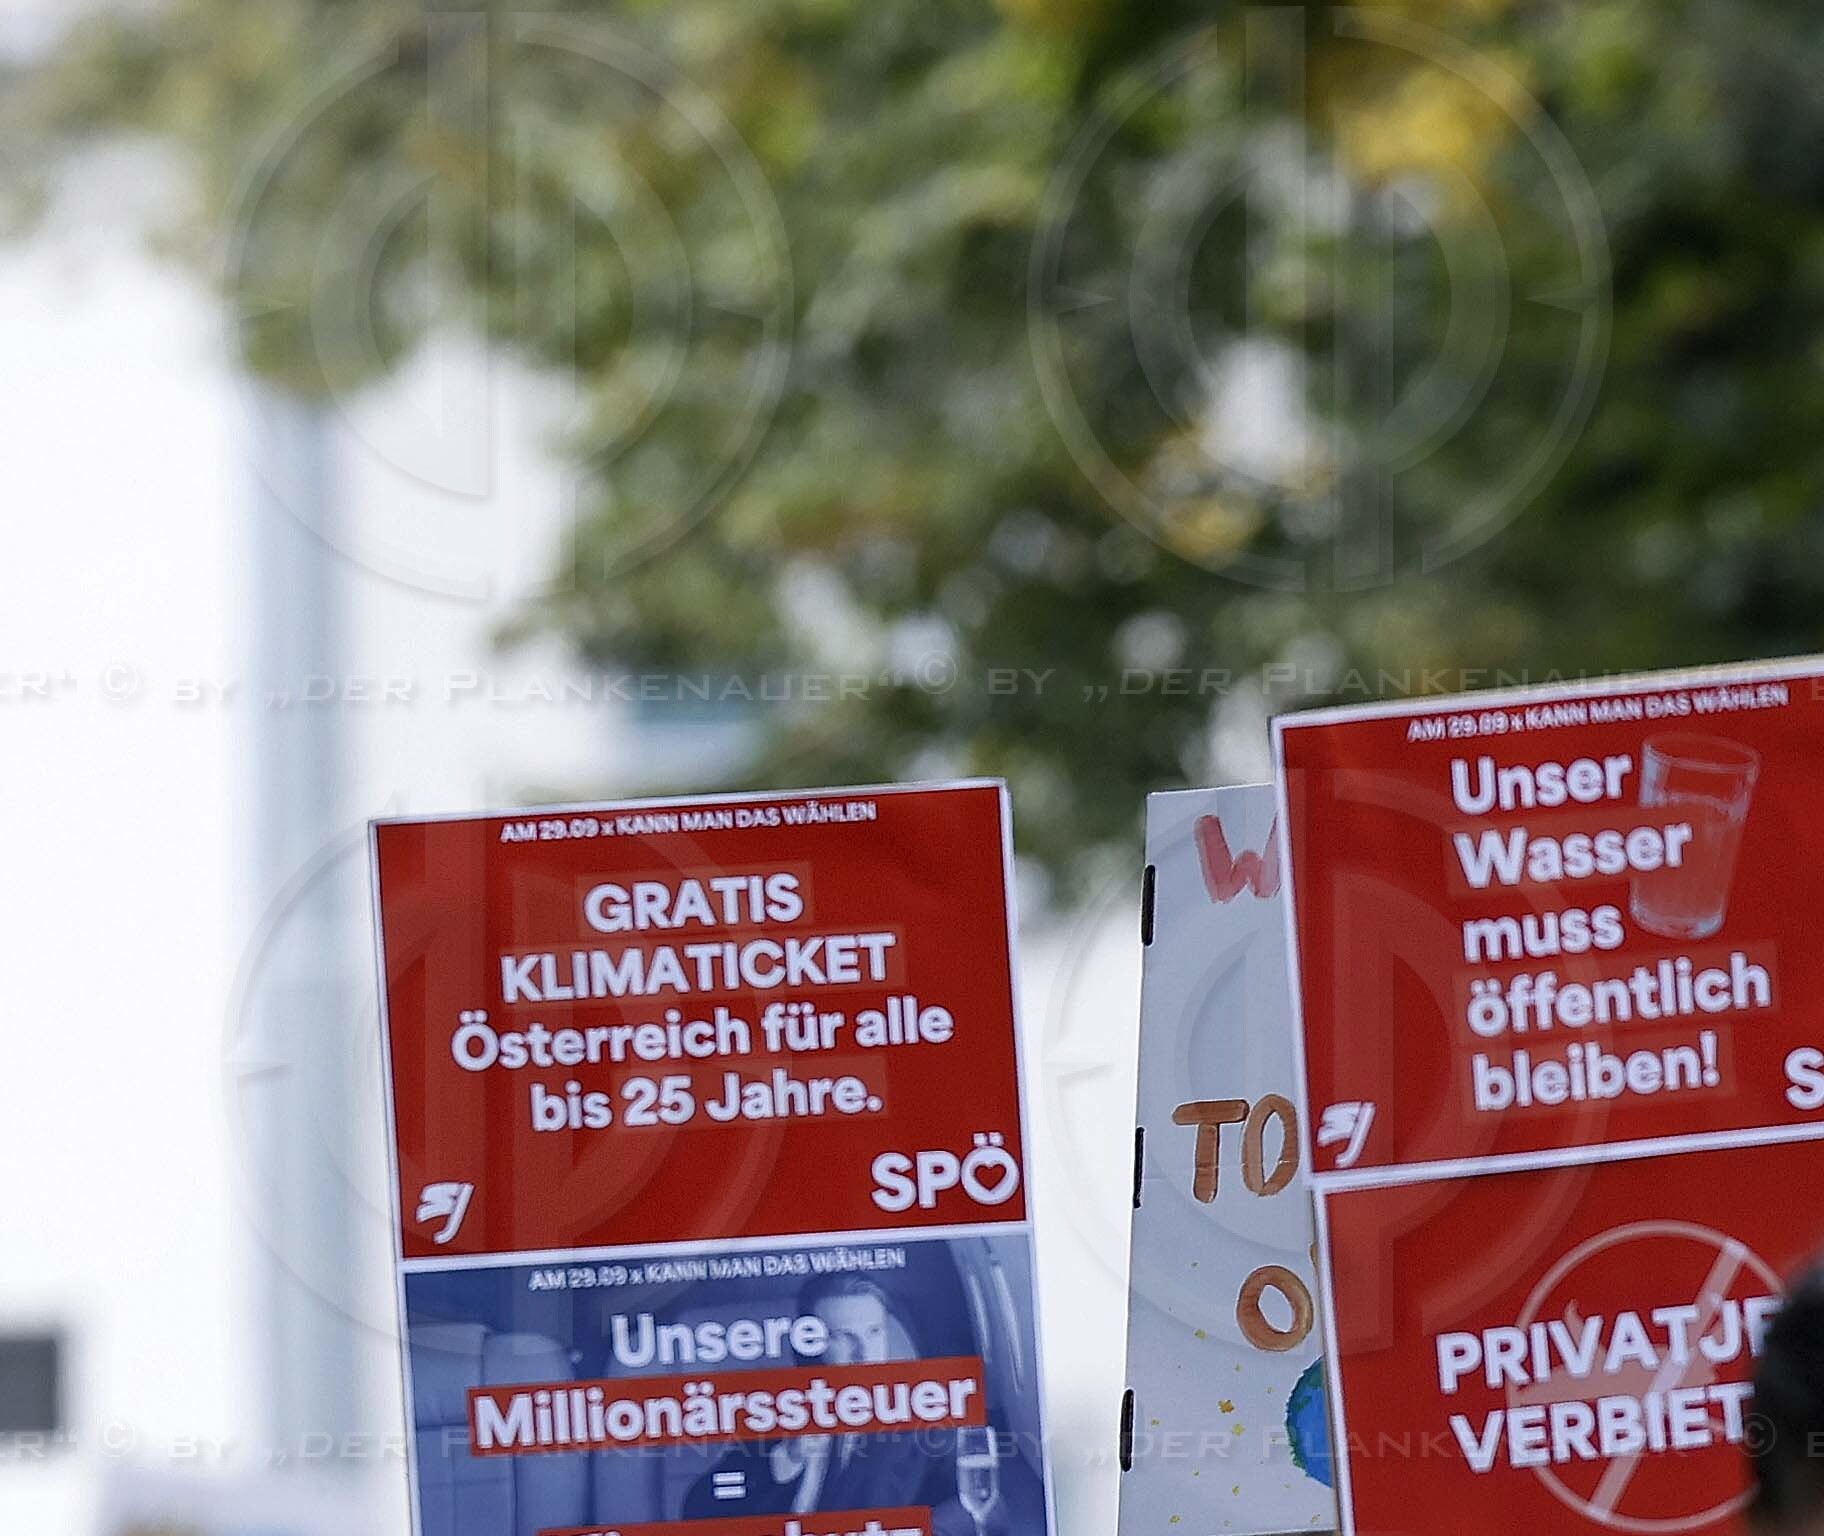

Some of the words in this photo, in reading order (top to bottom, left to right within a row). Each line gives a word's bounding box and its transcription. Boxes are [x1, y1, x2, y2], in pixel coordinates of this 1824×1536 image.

[1407, 719, 1446, 742] AM
[1525, 702, 1587, 729] KANN
[1590, 699, 1644, 724] MAN
[1645, 696, 1691, 720] DAS
[1692, 686, 1789, 714] WÄHLEN
[1452, 756, 1630, 813] Unser
[500, 822, 537, 843] AM
[615, 813, 678, 835] KANN
[680, 810, 734, 832] MAN
[735, 807, 780, 828] DAS
[780, 800, 877, 825] WÄHLEN
[1454, 823, 1691, 885] Wasser
[585, 873, 802, 932] GRATIS
[1464, 906, 1624, 961] muss
[502, 934, 895, 1003] KLIMATICKET
[1468, 953, 1770, 1036] öffentlich
[453, 1009, 749, 1070] Österreich
[762, 1004, 843, 1053] für
[856, 998, 952, 1045] alle
[531, 1084, 611, 1130] bis
[622, 1077, 694, 1125] 25
[706, 1070, 882, 1121] Jahre.
[1474, 1032, 1718, 1109] bleiben!
[873, 1133, 1018, 1211] SPÖ
[612, 1314, 829, 1365] Unsere
[1437, 1297, 1783, 1392] PRIVATJE
[474, 1377, 974, 1447] Millionärssteuer
[1450, 1383, 1752, 1474] VERBIET
